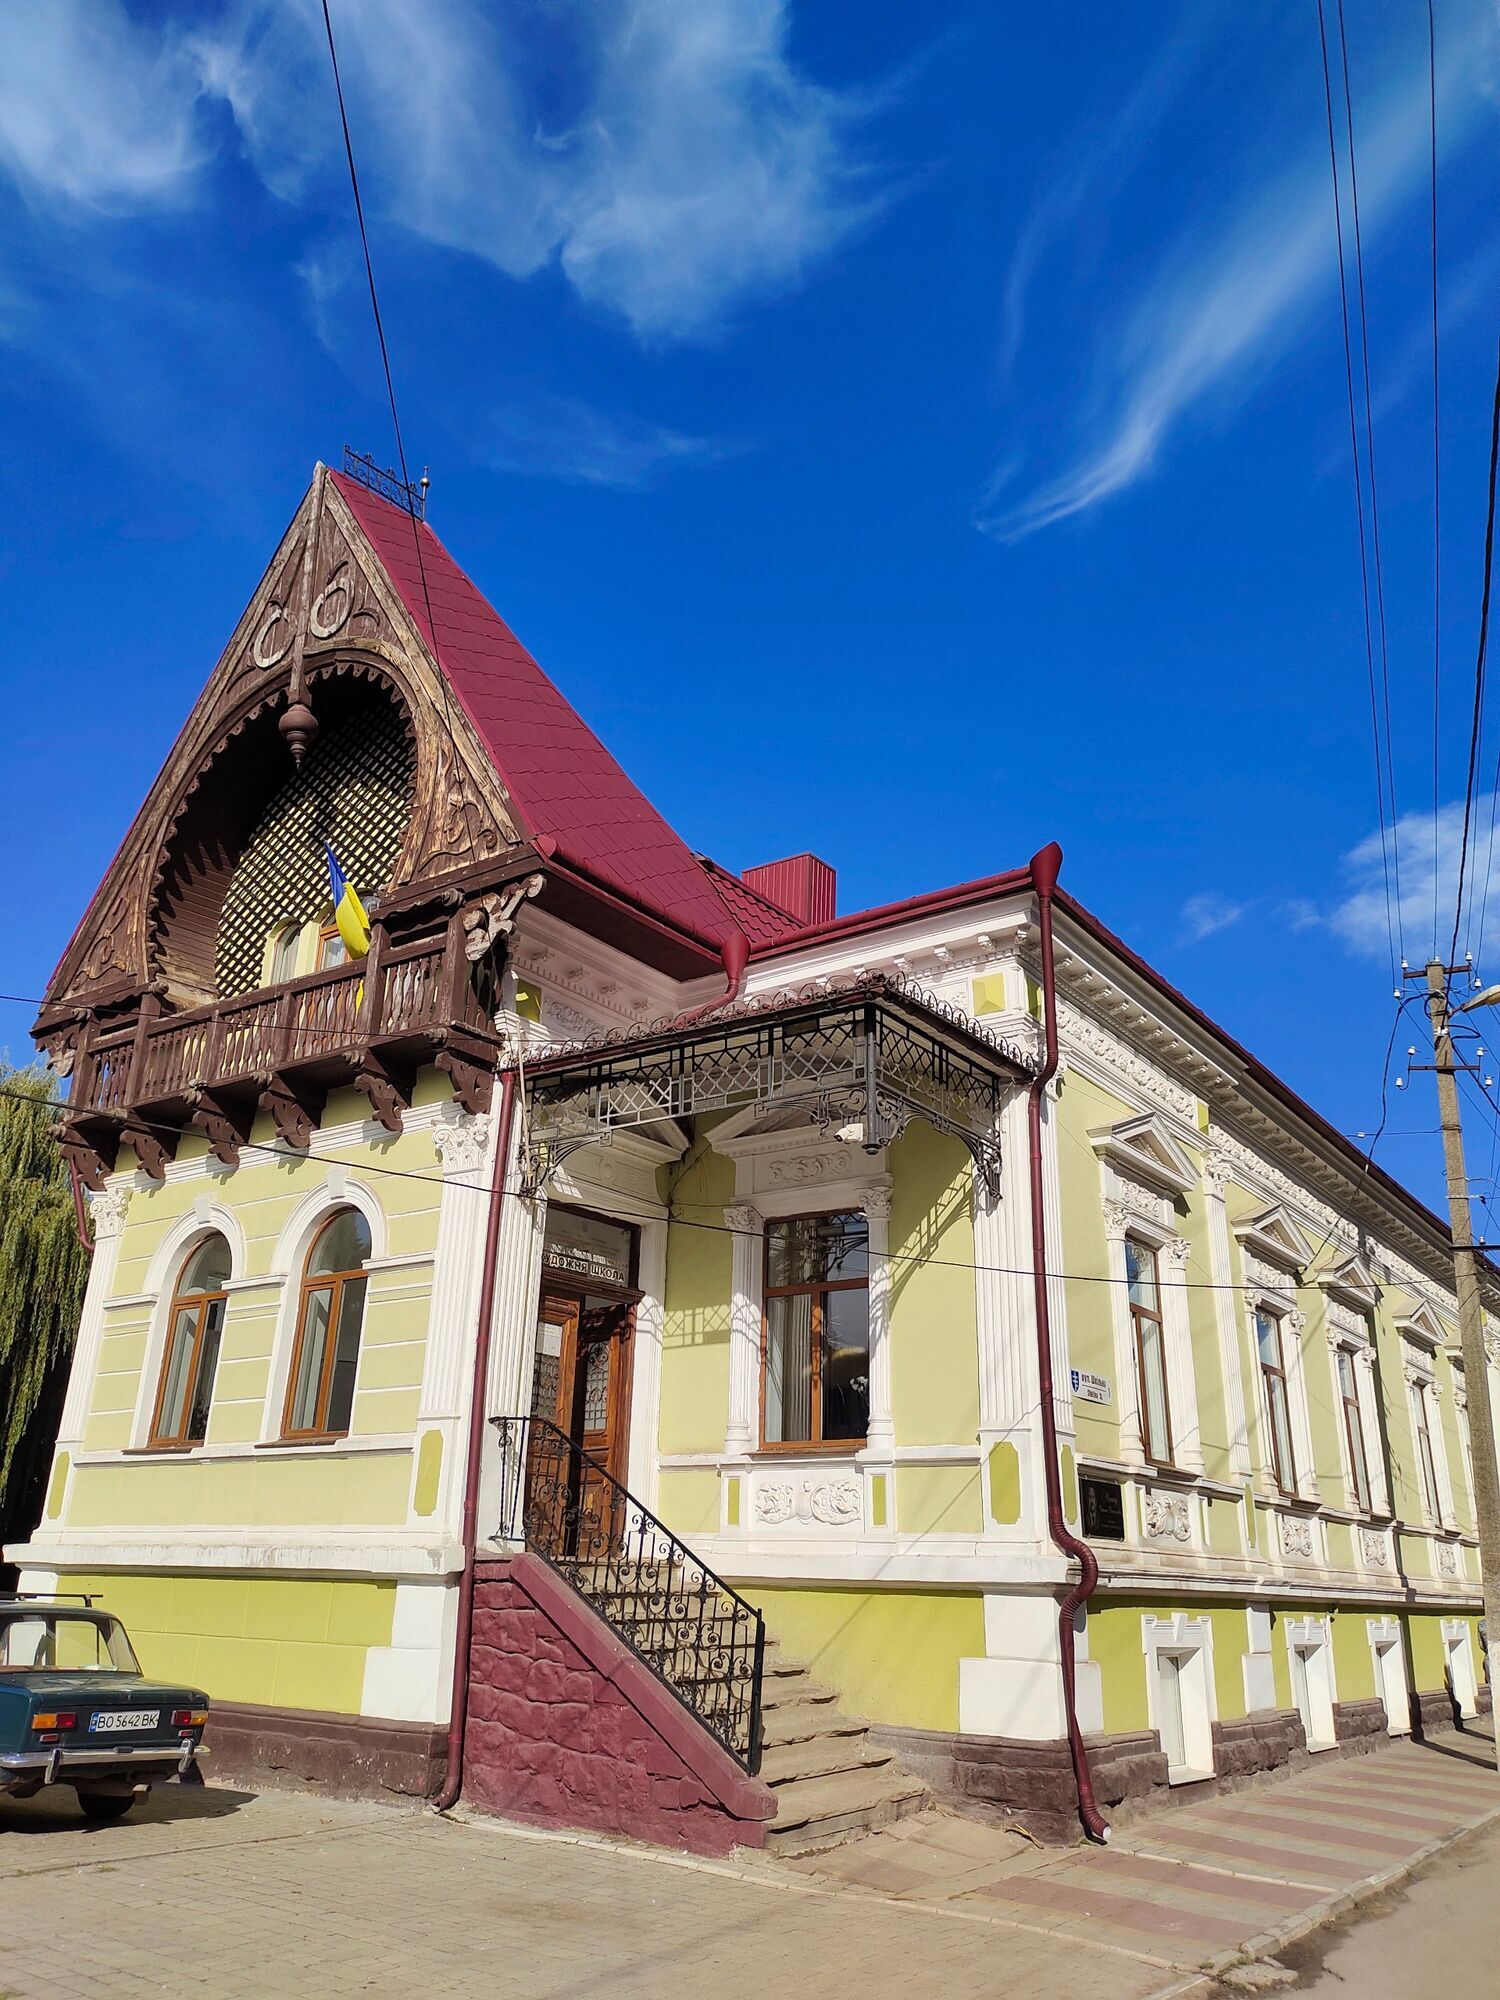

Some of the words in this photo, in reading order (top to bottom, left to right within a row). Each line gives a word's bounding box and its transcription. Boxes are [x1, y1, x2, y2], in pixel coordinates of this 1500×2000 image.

[542, 1254, 587, 1272] УДОЖНЯ
[592, 1265, 624, 1282] ШКОЛА
[1081, 1374, 1090, 1383] вул.
[97, 1716, 114, 1728] BO
[115, 1714, 140, 1727] 5642
[141, 1713, 158, 1726] BK
